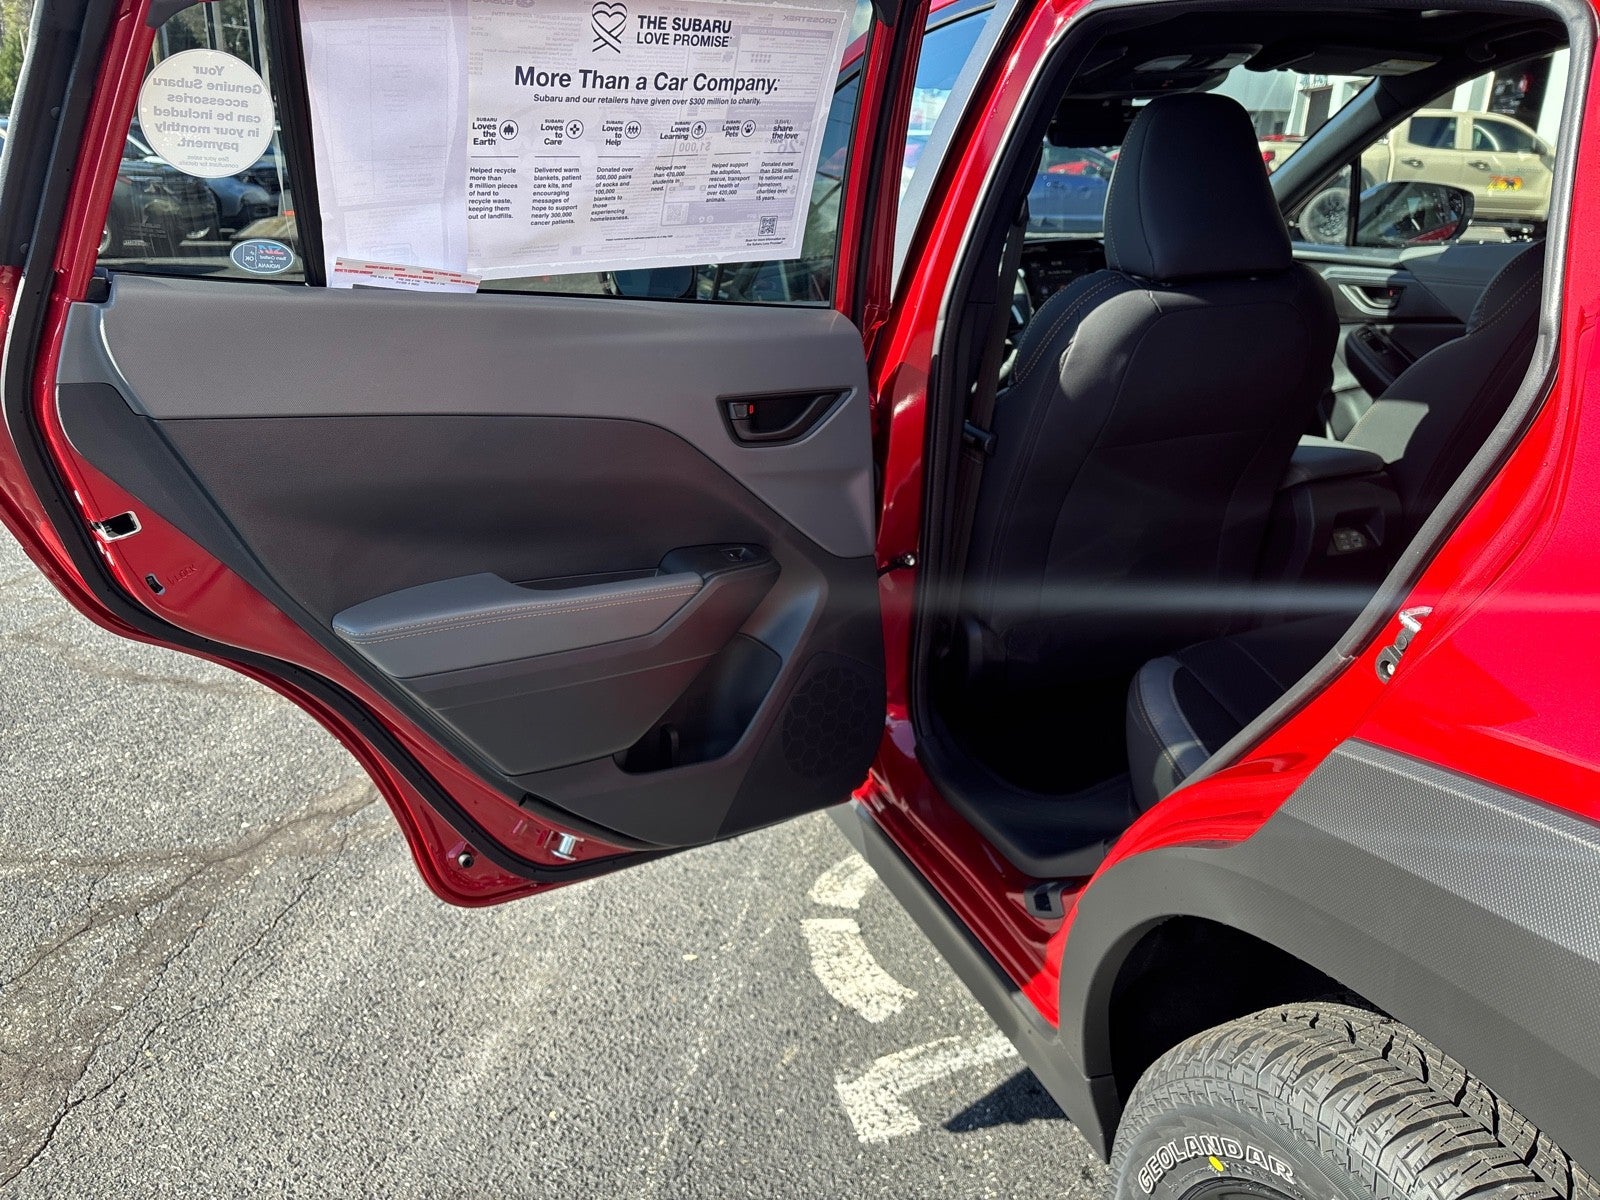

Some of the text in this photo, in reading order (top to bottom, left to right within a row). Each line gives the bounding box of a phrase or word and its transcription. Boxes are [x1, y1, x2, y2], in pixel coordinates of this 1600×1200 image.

[638, 15, 667, 29] THE
[672, 17, 732, 33] SUBARU
[637, 32, 670, 45] LOVE
[515, 66, 571, 87] More
[579, 69, 629, 89] Than
[636, 77, 647, 90] a
[654, 72, 688, 90] Car
[534, 94, 563, 102] Subaru
[1138, 1136, 1296, 1193] GEOLANDAR
